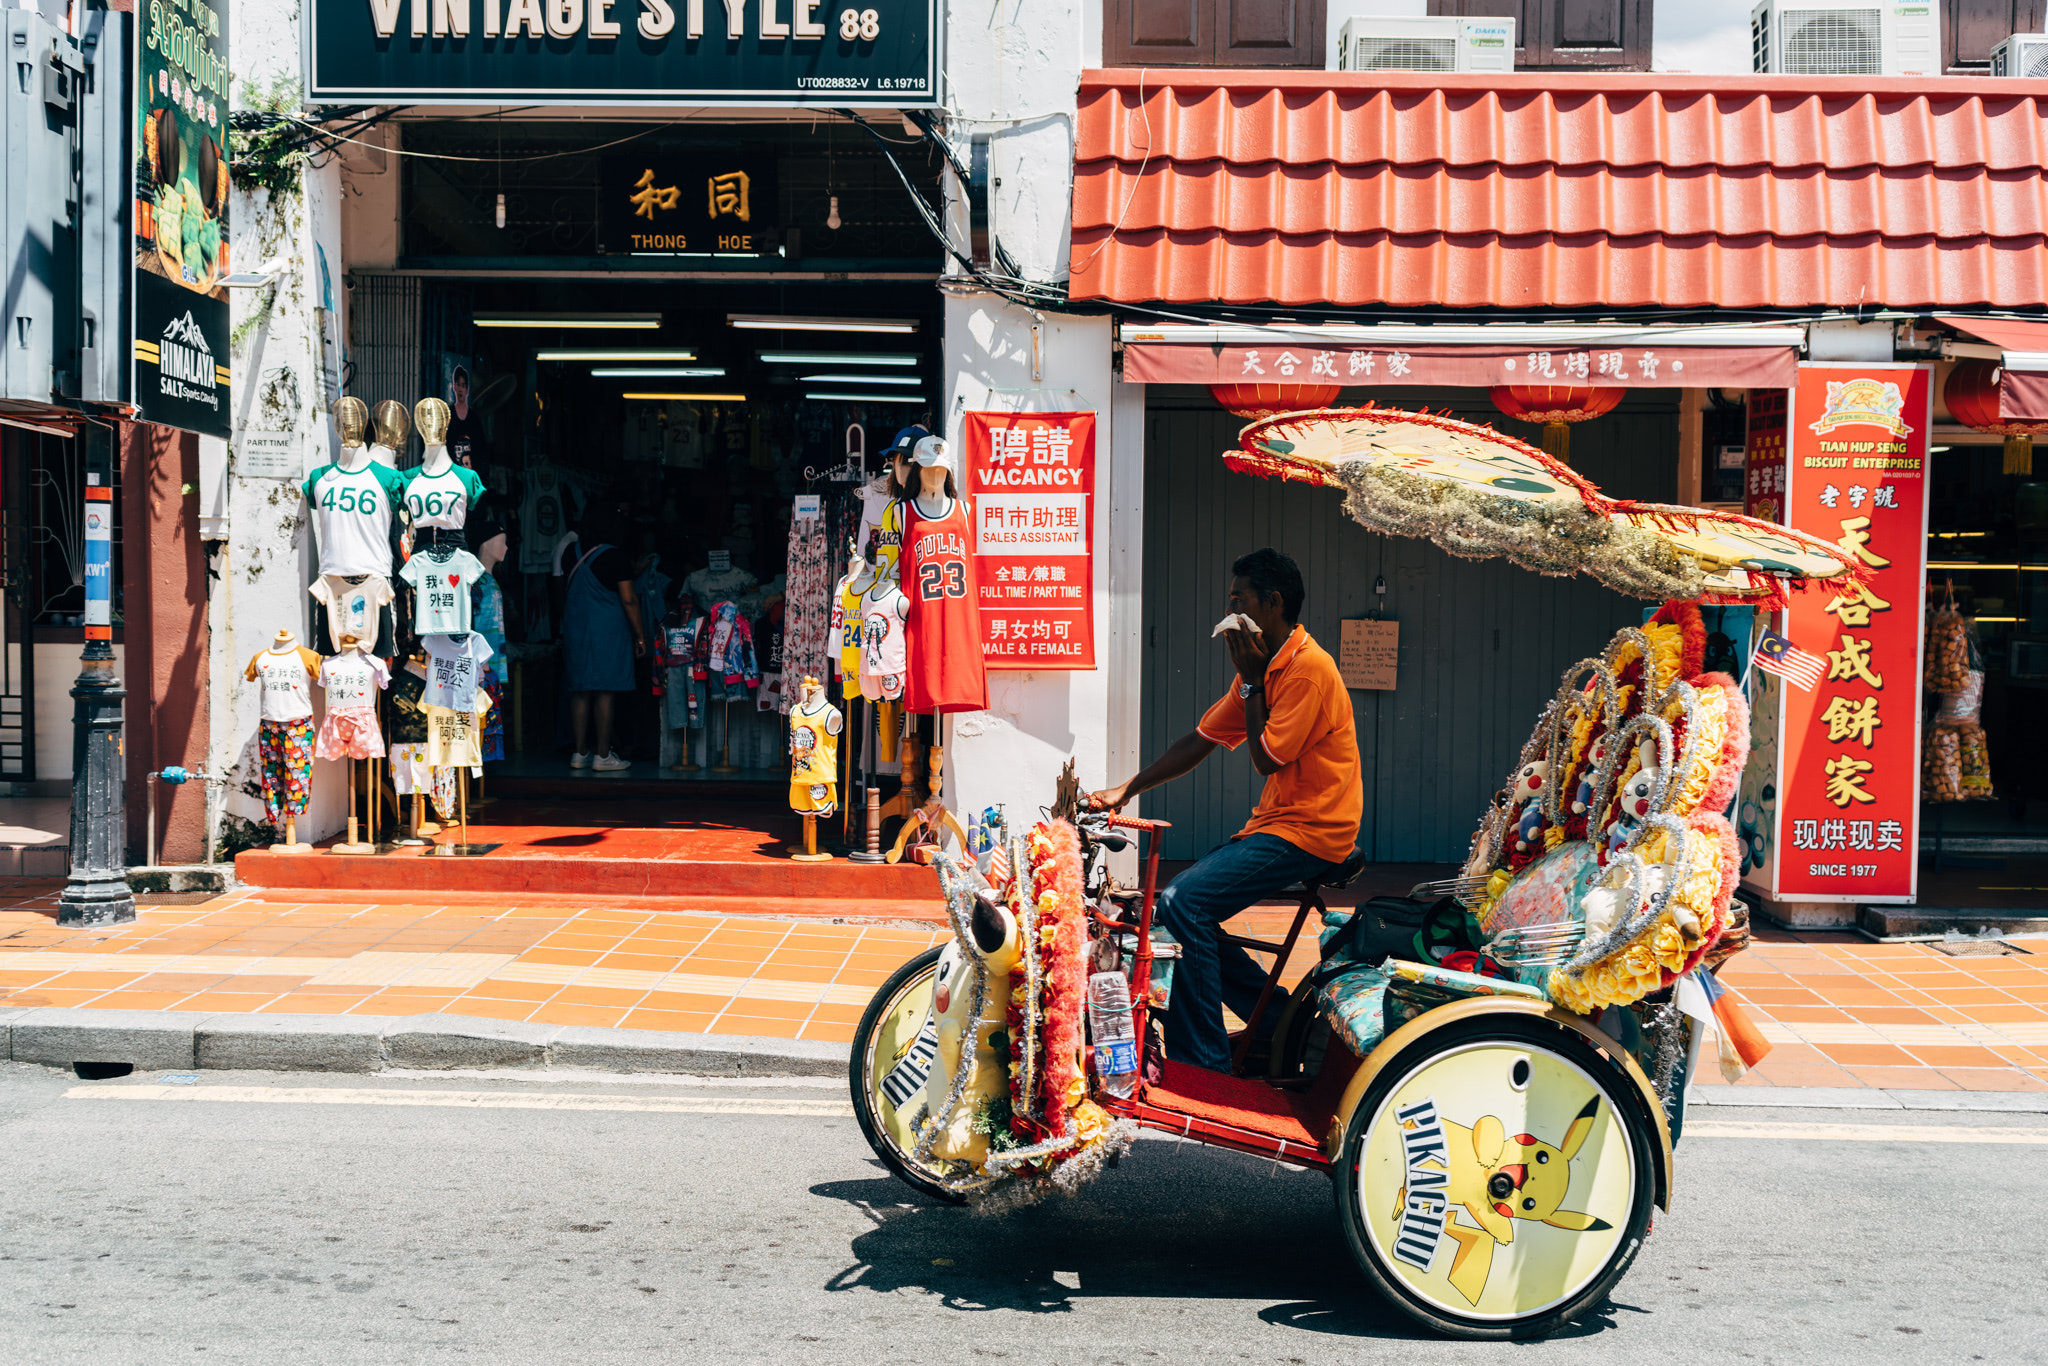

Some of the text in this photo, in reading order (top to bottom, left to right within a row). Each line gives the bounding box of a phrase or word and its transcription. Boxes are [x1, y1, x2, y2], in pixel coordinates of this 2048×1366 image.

[840, 8, 880, 41] 88
[147, 0, 227, 100] Aidilfitri
[797, 77, 926, 88] UT0028832-V L6.19718
[629, 168, 750, 222] 和同
[631, 234, 752, 249] THONG HOE
[160, 339, 217, 390] HIMALAYA
[1241, 350, 1411, 378] 天合成餅家
[160, 376, 218, 412] SALT Sports Candy
[989, 426, 1074, 467] 聘請
[1819, 441, 1907, 454] TIAN HUP SENG
[1803, 456, 1922, 470] BISCUIT ENTERPRISE
[978, 468, 1084, 486] VACANCY
[321, 487, 377, 515] 456
[408, 491, 461, 519] 067
[1819, 484, 1899, 508] 老字號
[984, 506, 1079, 528] 門市助理
[915, 533, 966, 566] BULLS
[983, 532, 1079, 543] SALES ASSISTANT
[919, 560, 967, 601] 23
[995, 566, 1067, 582] 全職/兼職
[429, 593, 454, 607] 外婆
[980, 586, 1082, 598] FULL TIME / PART TIME
[843, 624, 861, 648] 24
[990, 619, 1072, 640] 男女均可
[981, 643, 1082, 655] MALE & FEMALE
[436, 669, 463, 688] 阿公
[1792, 818, 1903, 851] 现烘现卖
[1809, 864, 1878, 877] SINCE 1977
[1396, 1099, 1449, 1271] PIKACHU
